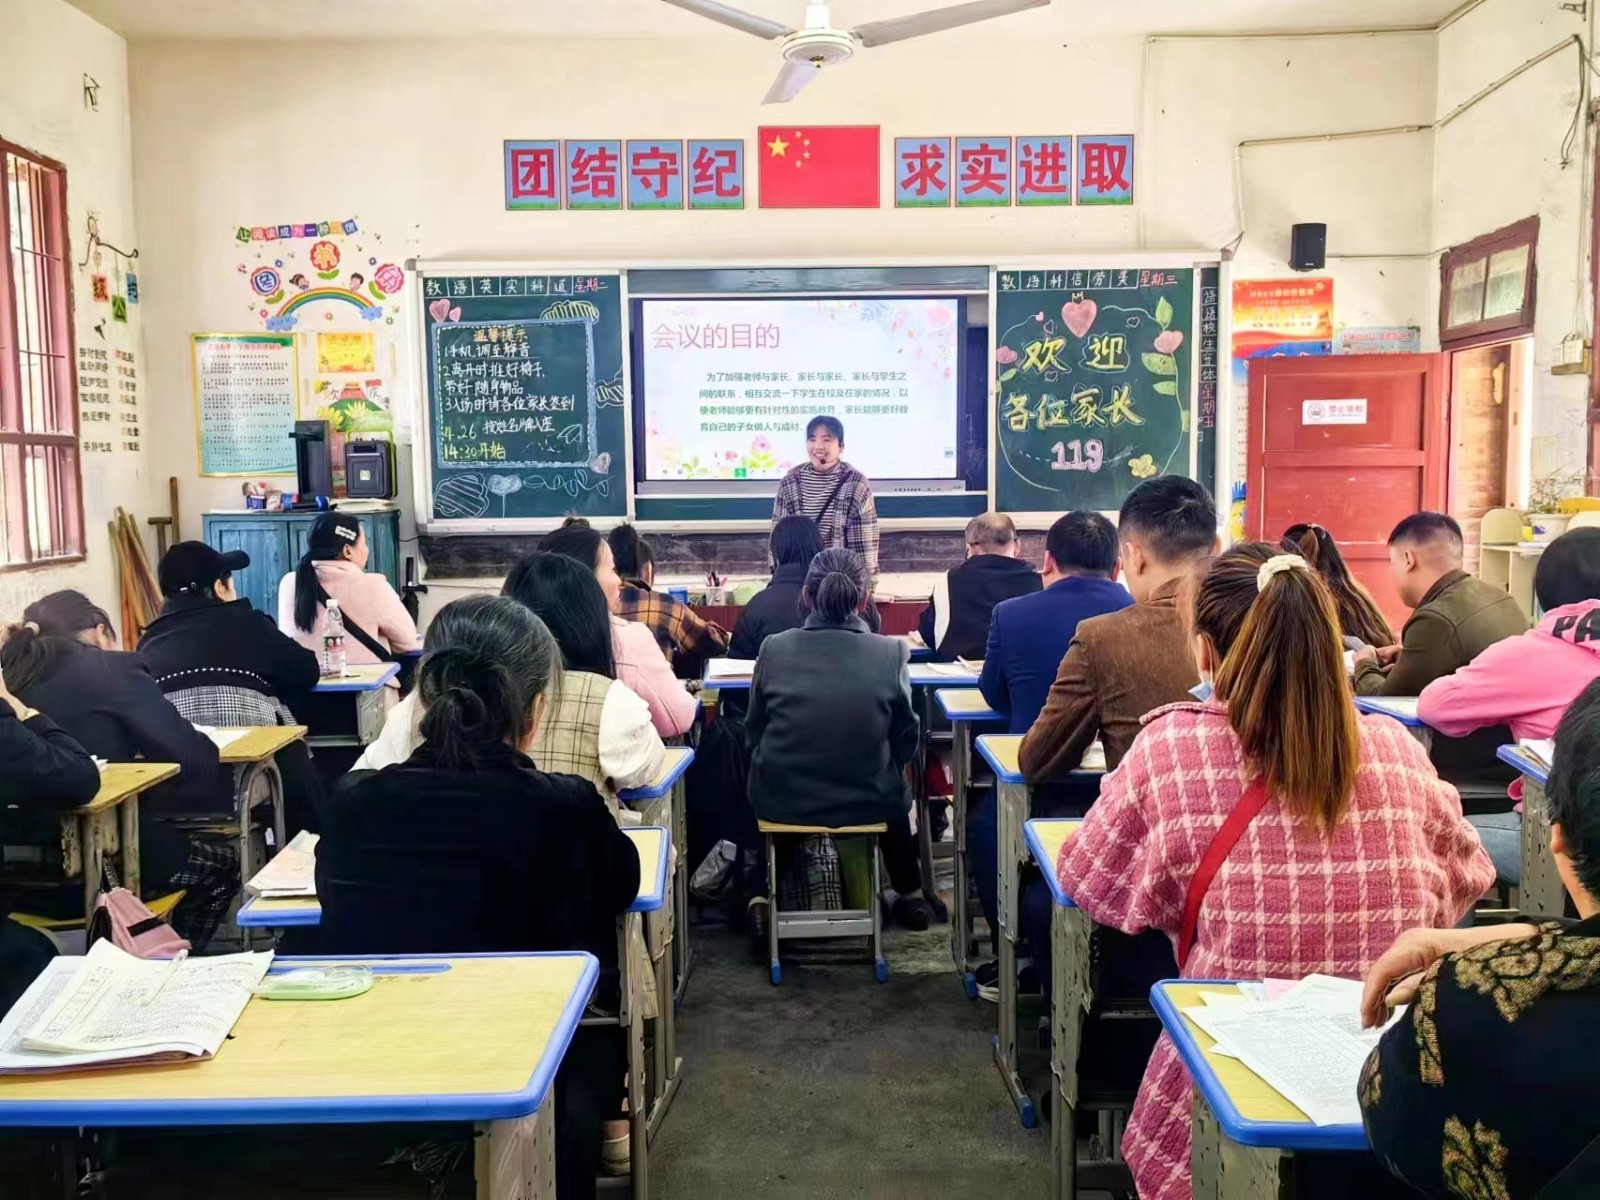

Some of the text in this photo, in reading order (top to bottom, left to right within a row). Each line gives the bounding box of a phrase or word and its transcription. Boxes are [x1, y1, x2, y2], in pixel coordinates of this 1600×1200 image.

[511, 146, 740, 198] 团结守纪
[900, 142, 1130, 196] 求实进取
[574, 276, 608, 293] 星期二
[1139, 270, 1178, 288] 星期三
[473, 327, 528, 343] 温馨提示
[651, 323, 780, 349] 会议的目的
[1019, 334, 1129, 373] 欢迎
[1002, 384, 1145, 431] 各位家长
[443, 423, 477, 441] 4.26
[1050, 438, 1104, 473] 119
